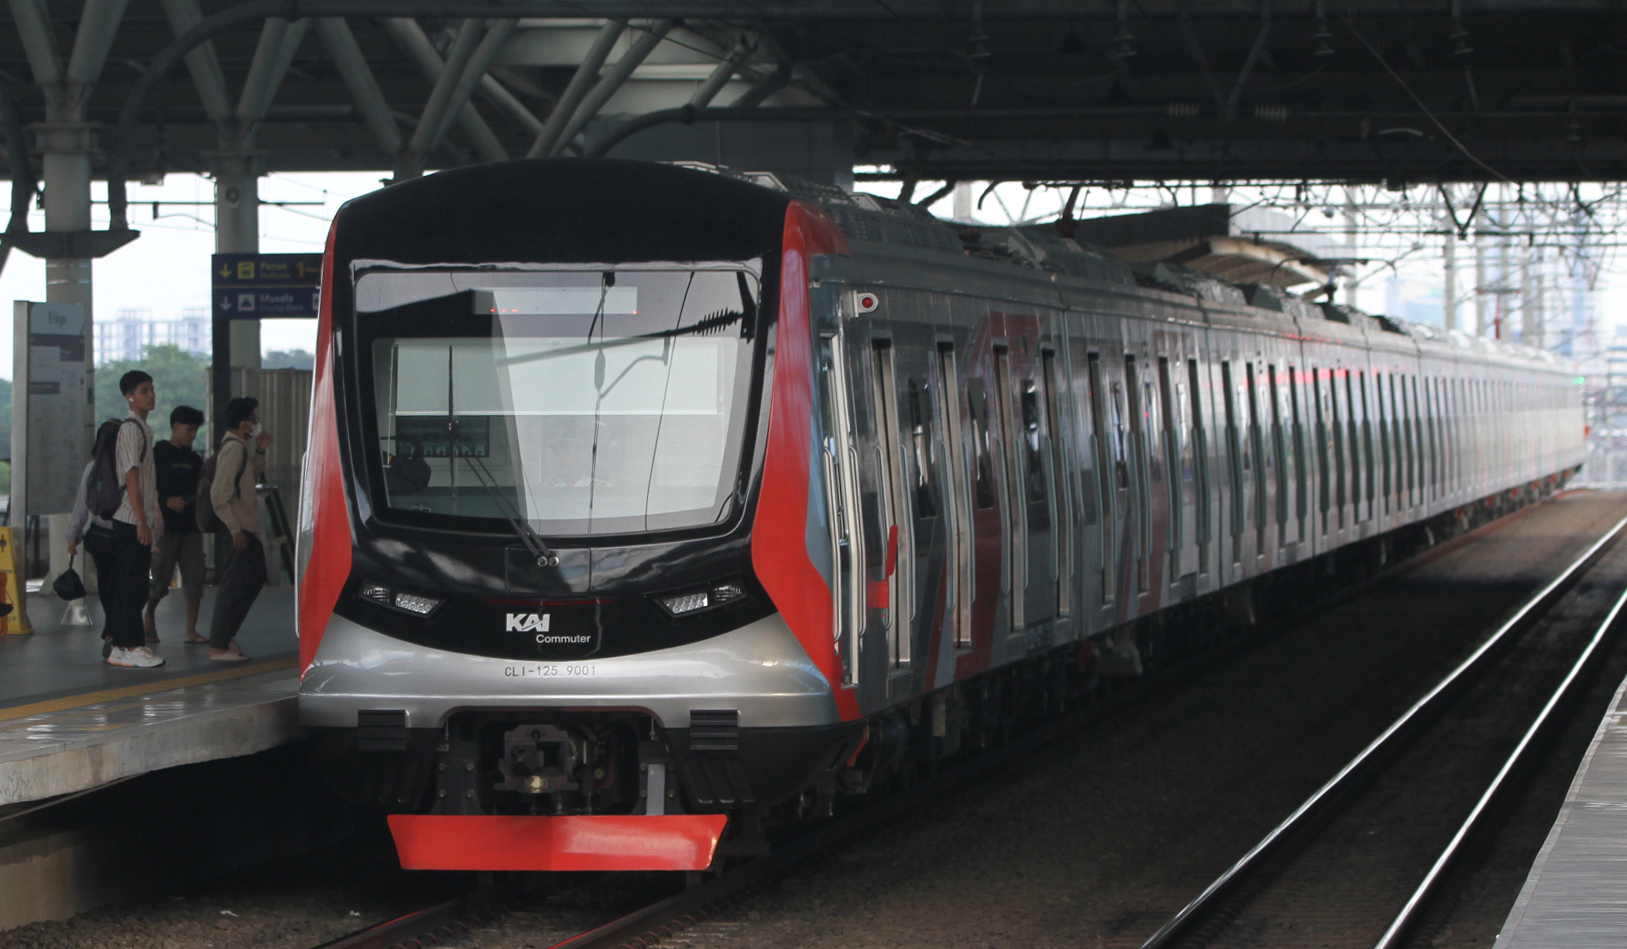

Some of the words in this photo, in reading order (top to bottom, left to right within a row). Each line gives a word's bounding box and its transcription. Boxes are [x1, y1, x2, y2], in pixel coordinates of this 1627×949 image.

[506, 613, 551, 632] KAI
[535, 634, 591, 644] Commuter
[504, 665, 597, 677] CLI-125.9001
